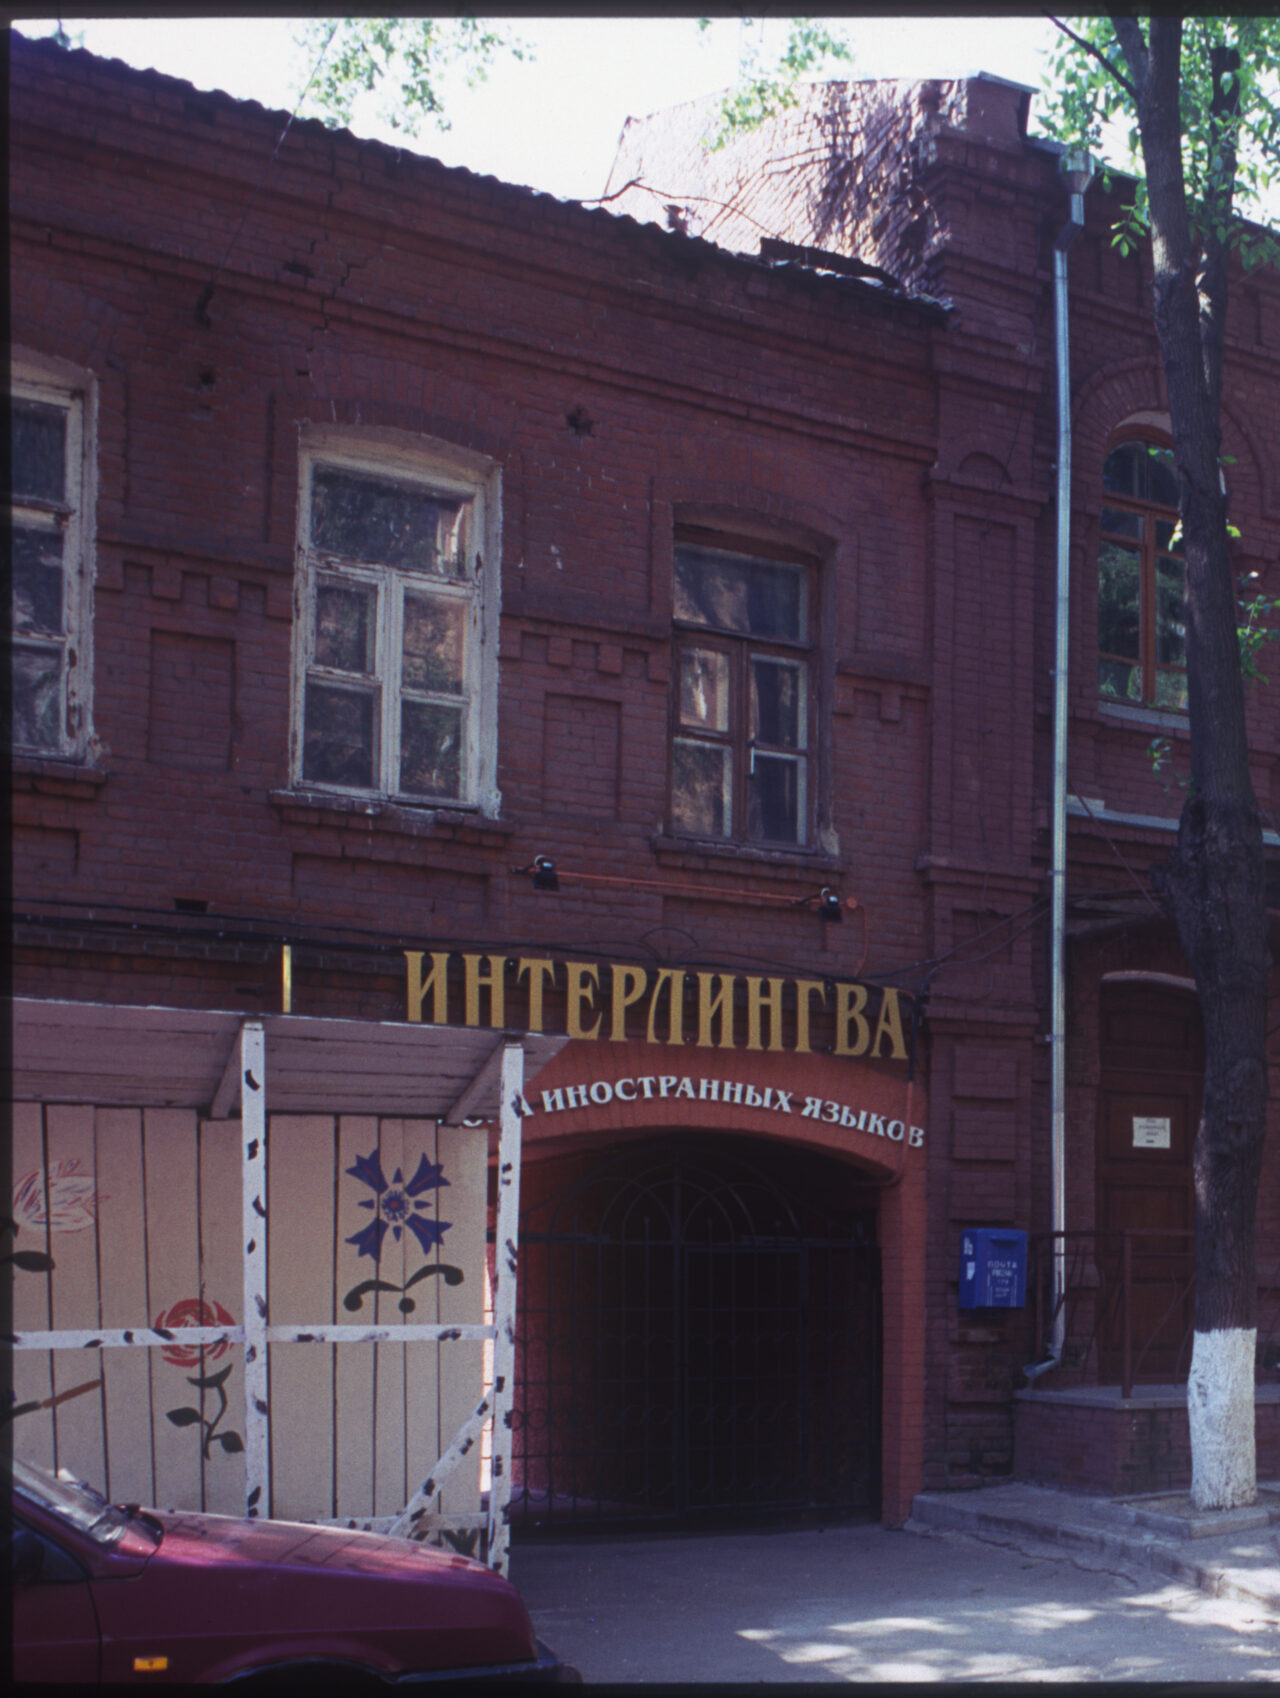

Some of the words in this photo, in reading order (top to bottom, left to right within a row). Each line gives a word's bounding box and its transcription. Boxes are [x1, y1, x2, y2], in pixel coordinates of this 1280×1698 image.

[403, 950, 908, 1060] ИНТЕРЛИНГВА
[541, 1075, 794, 1113] ИНОСТРАННЫХ
[800, 1096, 925, 1148] ЯЗЫКОВ
